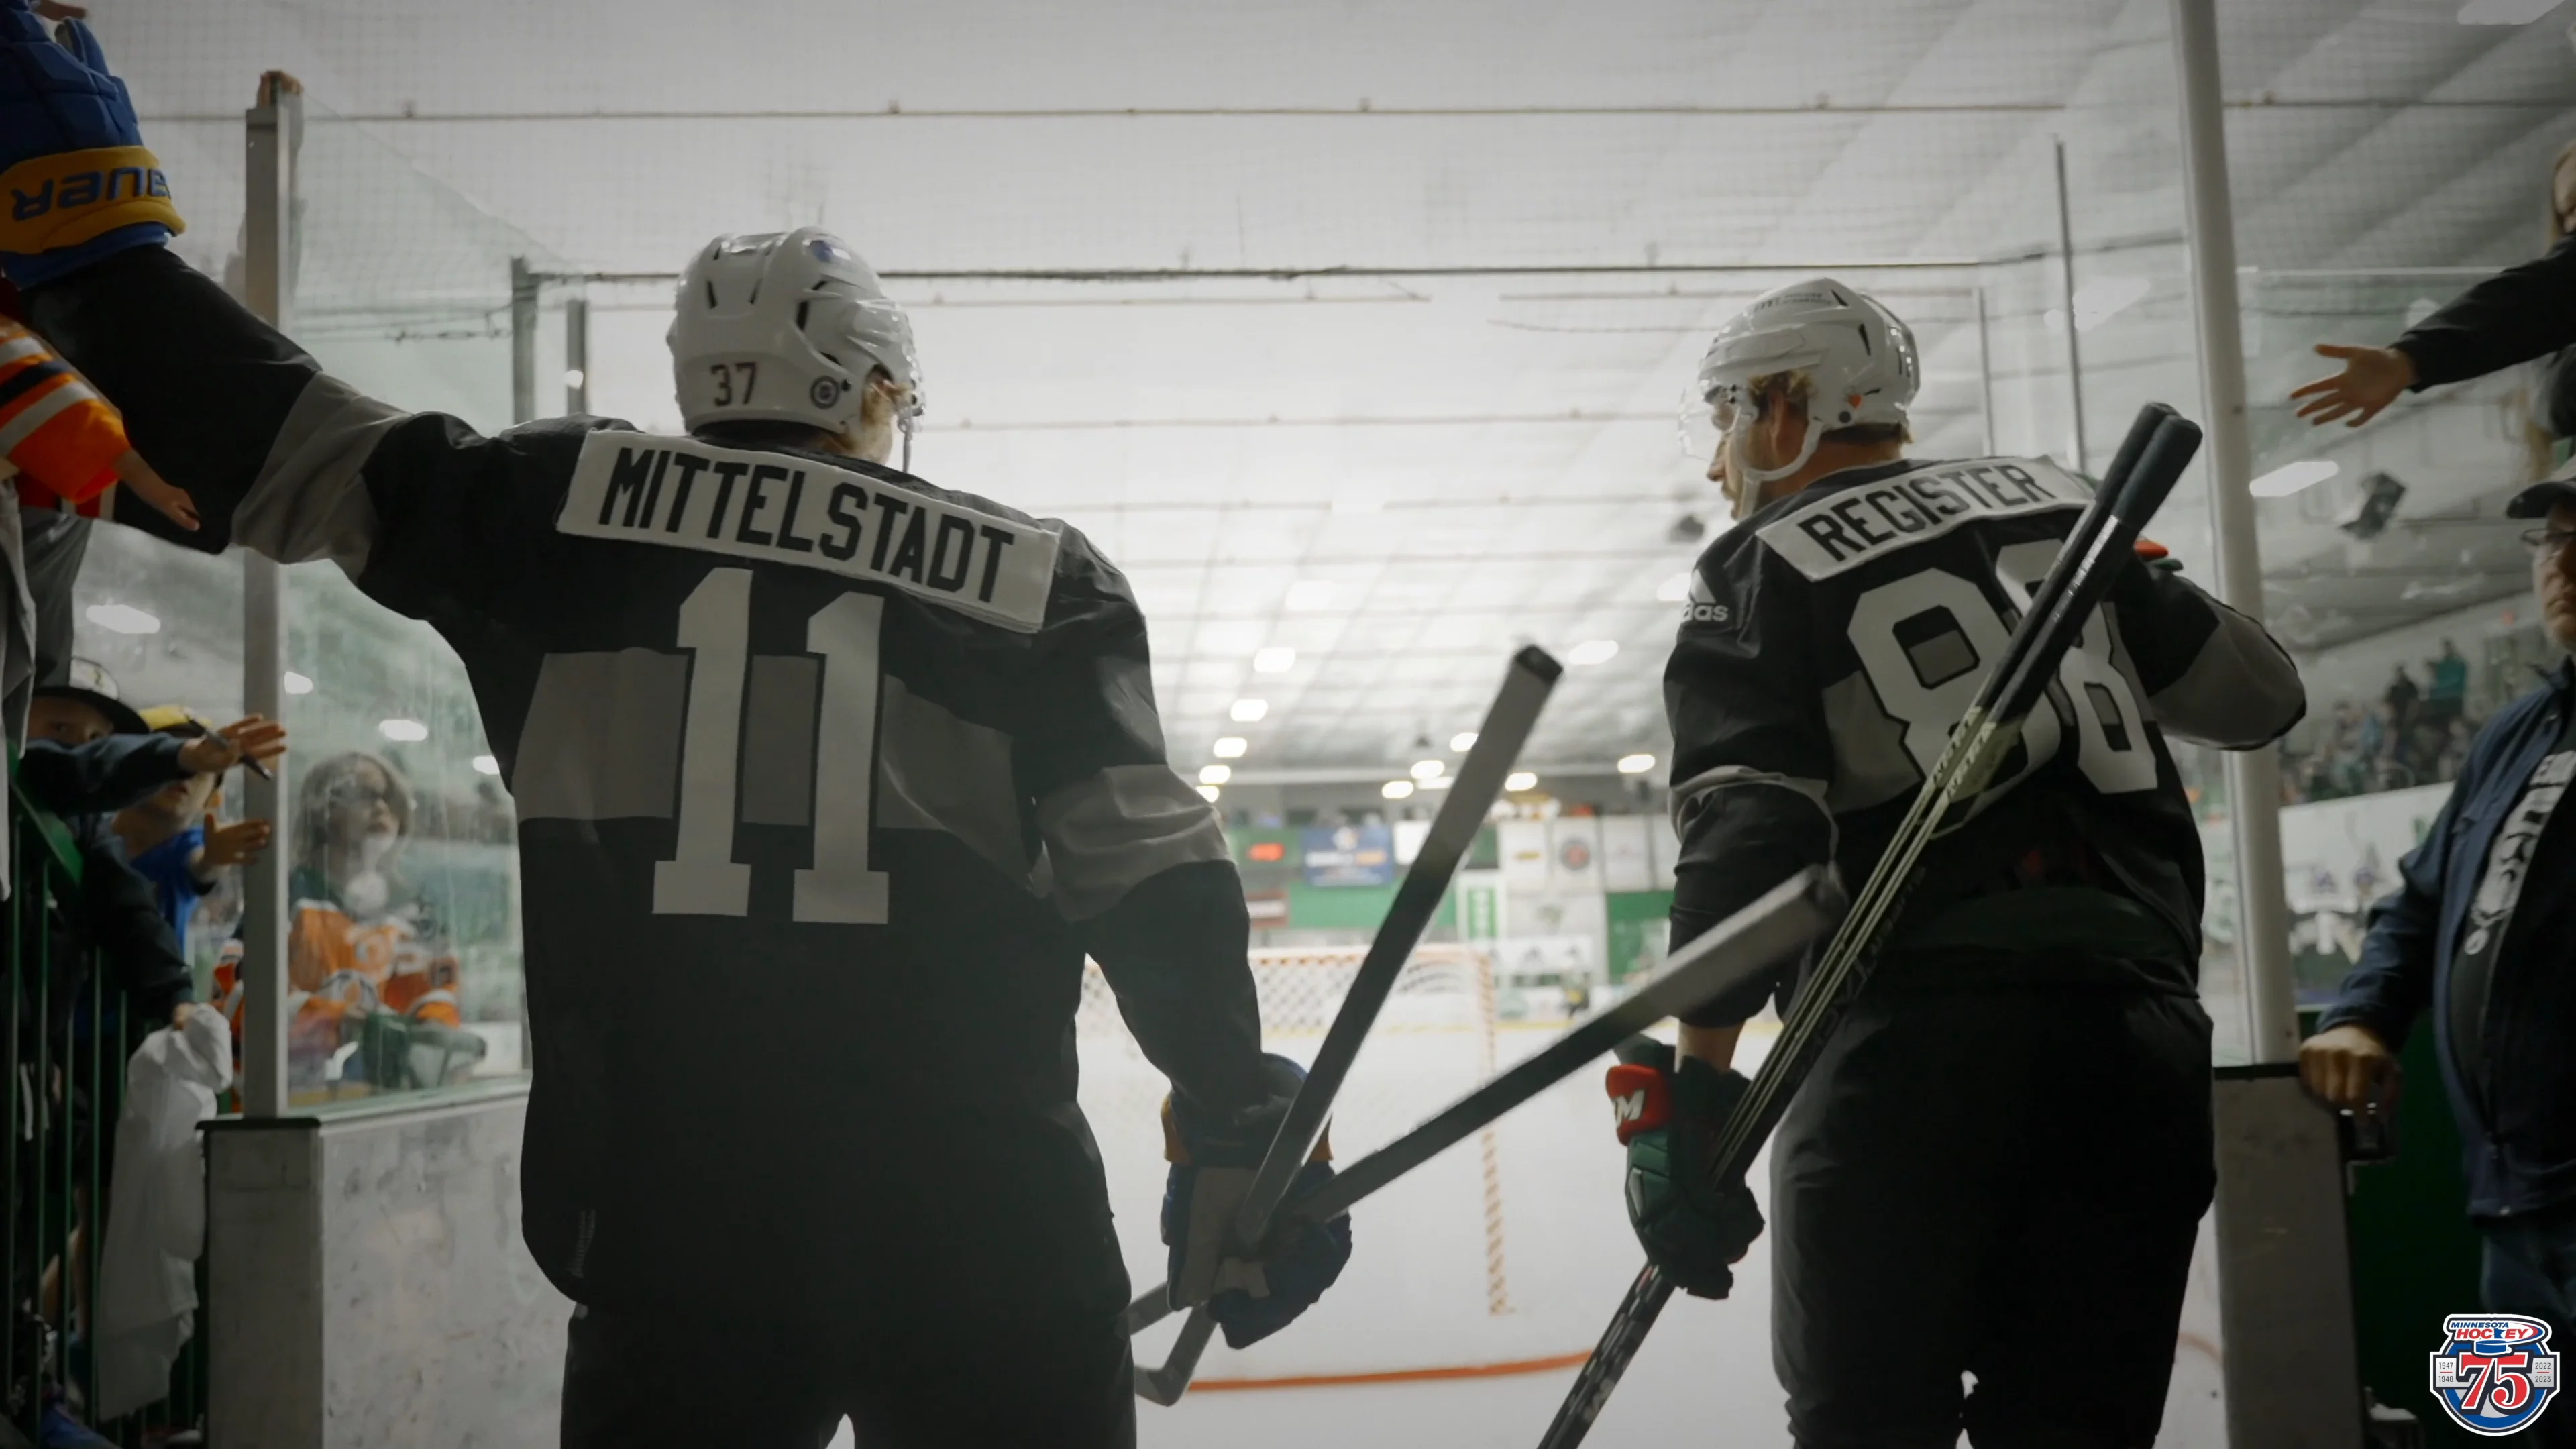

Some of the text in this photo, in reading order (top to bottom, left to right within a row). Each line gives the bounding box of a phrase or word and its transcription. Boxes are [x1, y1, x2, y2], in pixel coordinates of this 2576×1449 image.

[710, 362, 757, 406] 37
[599, 447, 1014, 604] MITTELSTADT
[1798, 464, 2055, 561] REGISTER
[1847, 539, 2158, 794] 88
[652, 567, 889, 924] 11
